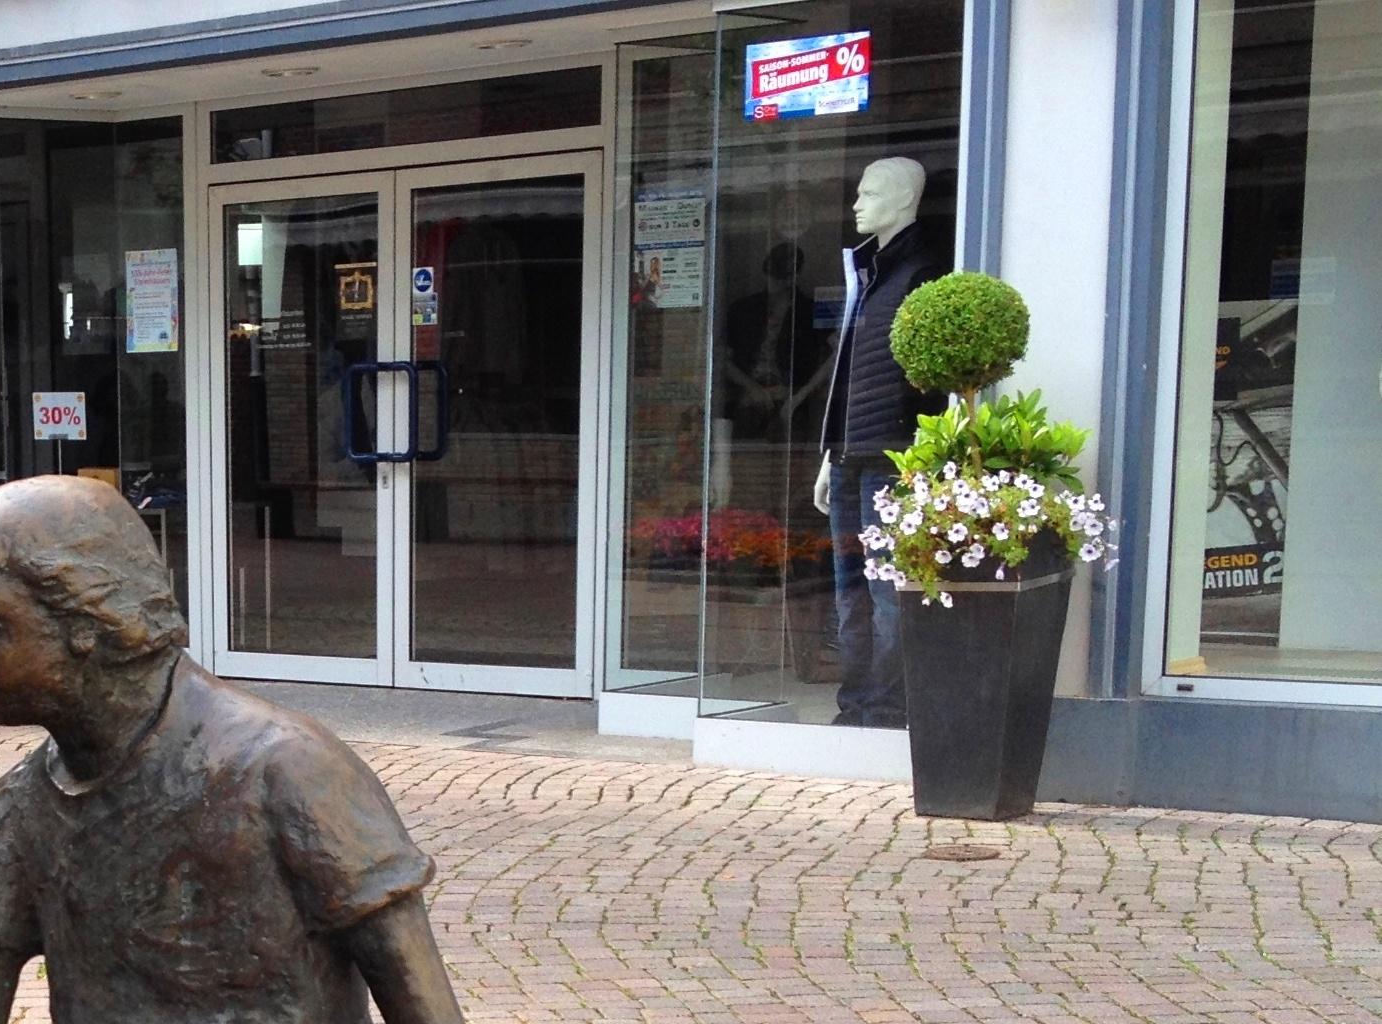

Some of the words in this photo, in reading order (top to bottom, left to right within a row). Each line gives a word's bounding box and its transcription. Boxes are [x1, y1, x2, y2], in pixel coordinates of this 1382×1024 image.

[759, 51, 829, 74] SAISON-SOMMER-
[836, 43, 865, 76] %
[760, 64, 829, 94] Räumung
[39, 406, 82, 426] 30%
[1204, 553, 1258, 569] GEND
